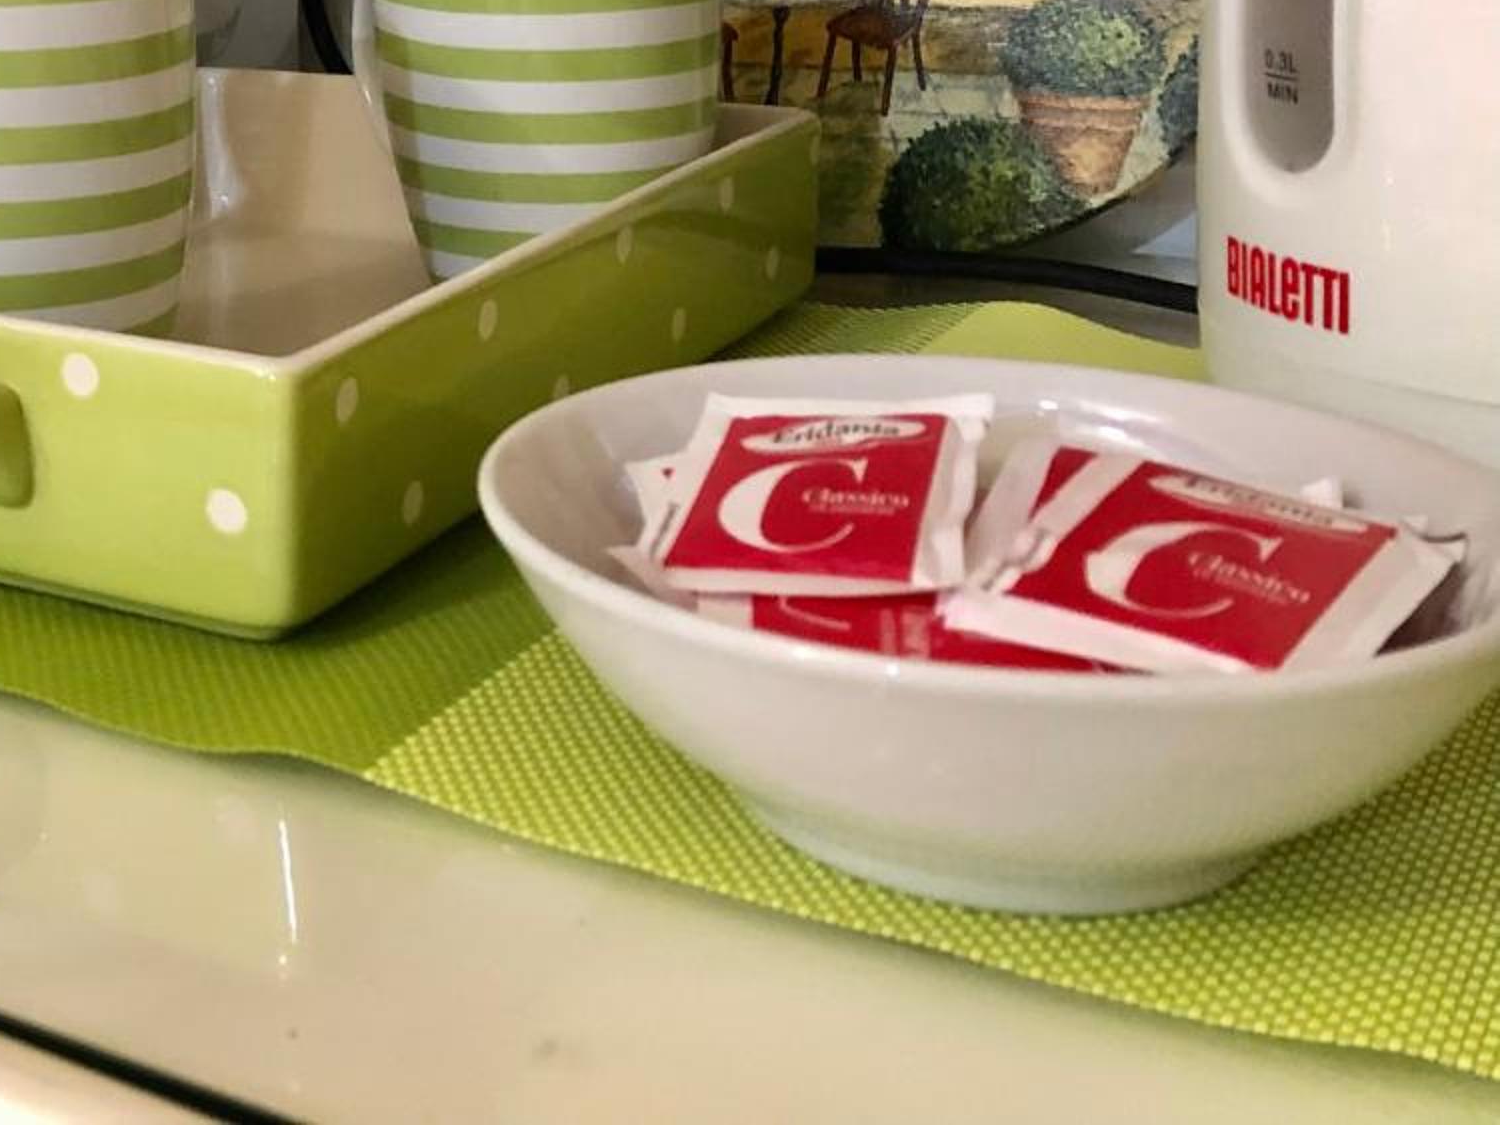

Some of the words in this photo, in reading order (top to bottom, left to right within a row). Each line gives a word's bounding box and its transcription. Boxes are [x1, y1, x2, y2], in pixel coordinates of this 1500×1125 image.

[1264, 48, 1297, 75] 0.3L
[1266, 82, 1300, 106] MIN
[717, 457, 869, 554] C
[801, 486, 910, 508] Classico
[1084, 520, 1284, 619] C
